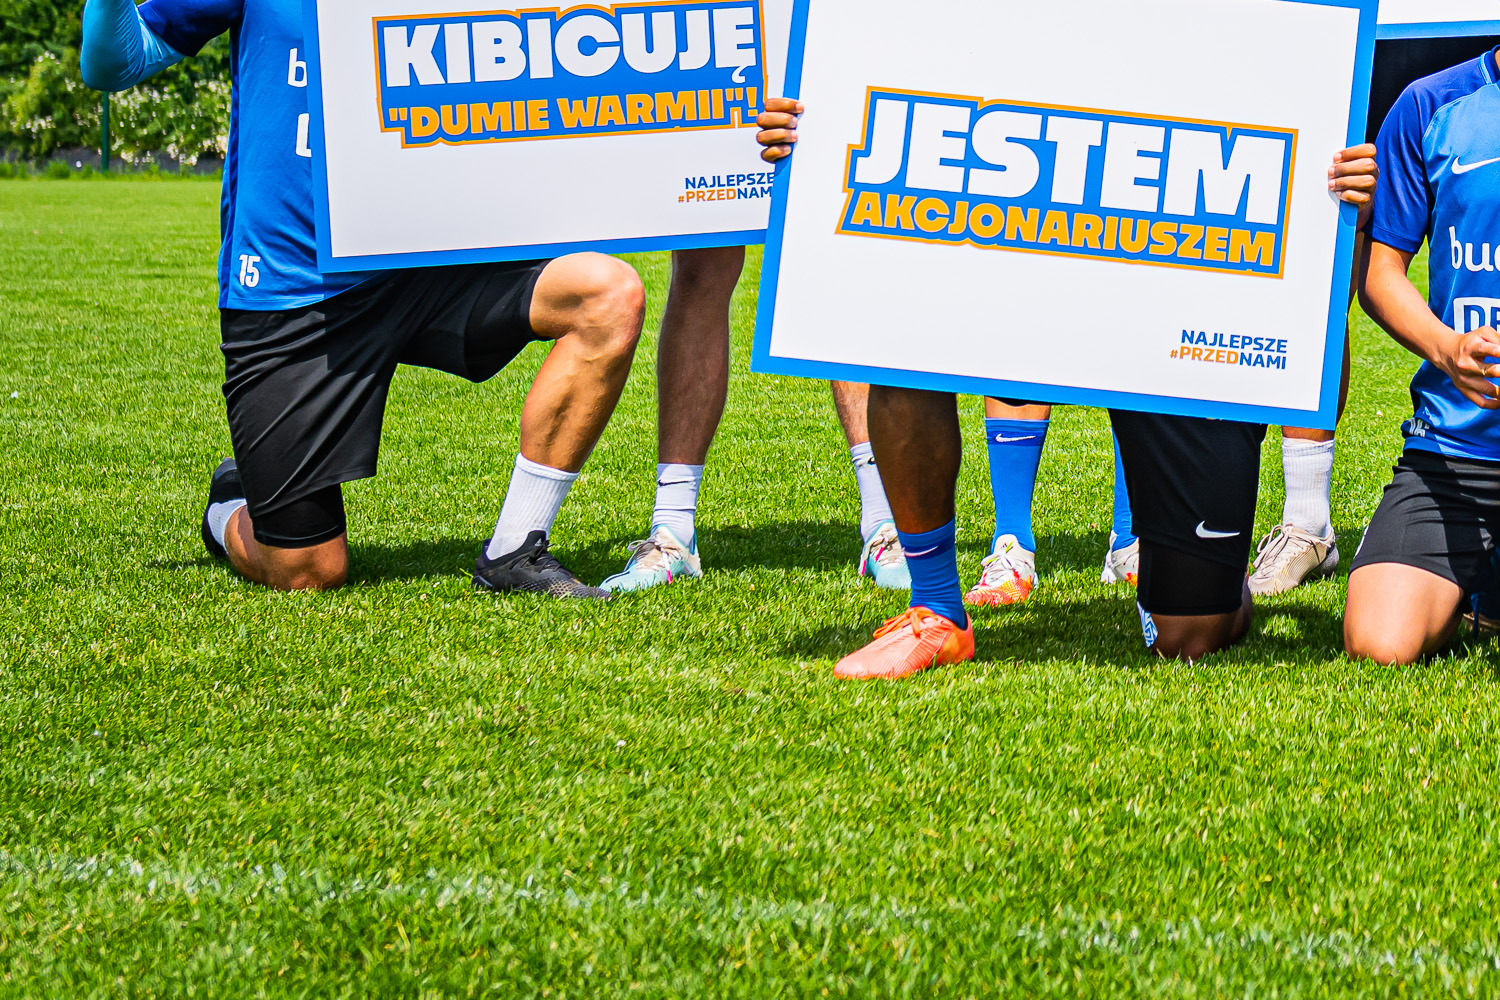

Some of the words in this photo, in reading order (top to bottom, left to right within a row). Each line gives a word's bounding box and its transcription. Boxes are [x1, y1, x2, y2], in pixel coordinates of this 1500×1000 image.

[383, 6, 757, 83] KIBICUJĘ
[389, 100, 550, 138] "DUMIE
[557, 87, 759, 129] WARMII"!
[854, 98, 1287, 225] JESTEM
[678, 186, 772, 203] #PRZEDNAM
[685, 172, 775, 190] NAJLEPSZE
[850, 191, 1276, 267] AKCJONARIUSZEM
[239, 254, 261, 288] 15
[1170, 345, 1287, 370] #PRZEDNAMI
[1181, 329, 1288, 353] NAJLEPSZE
